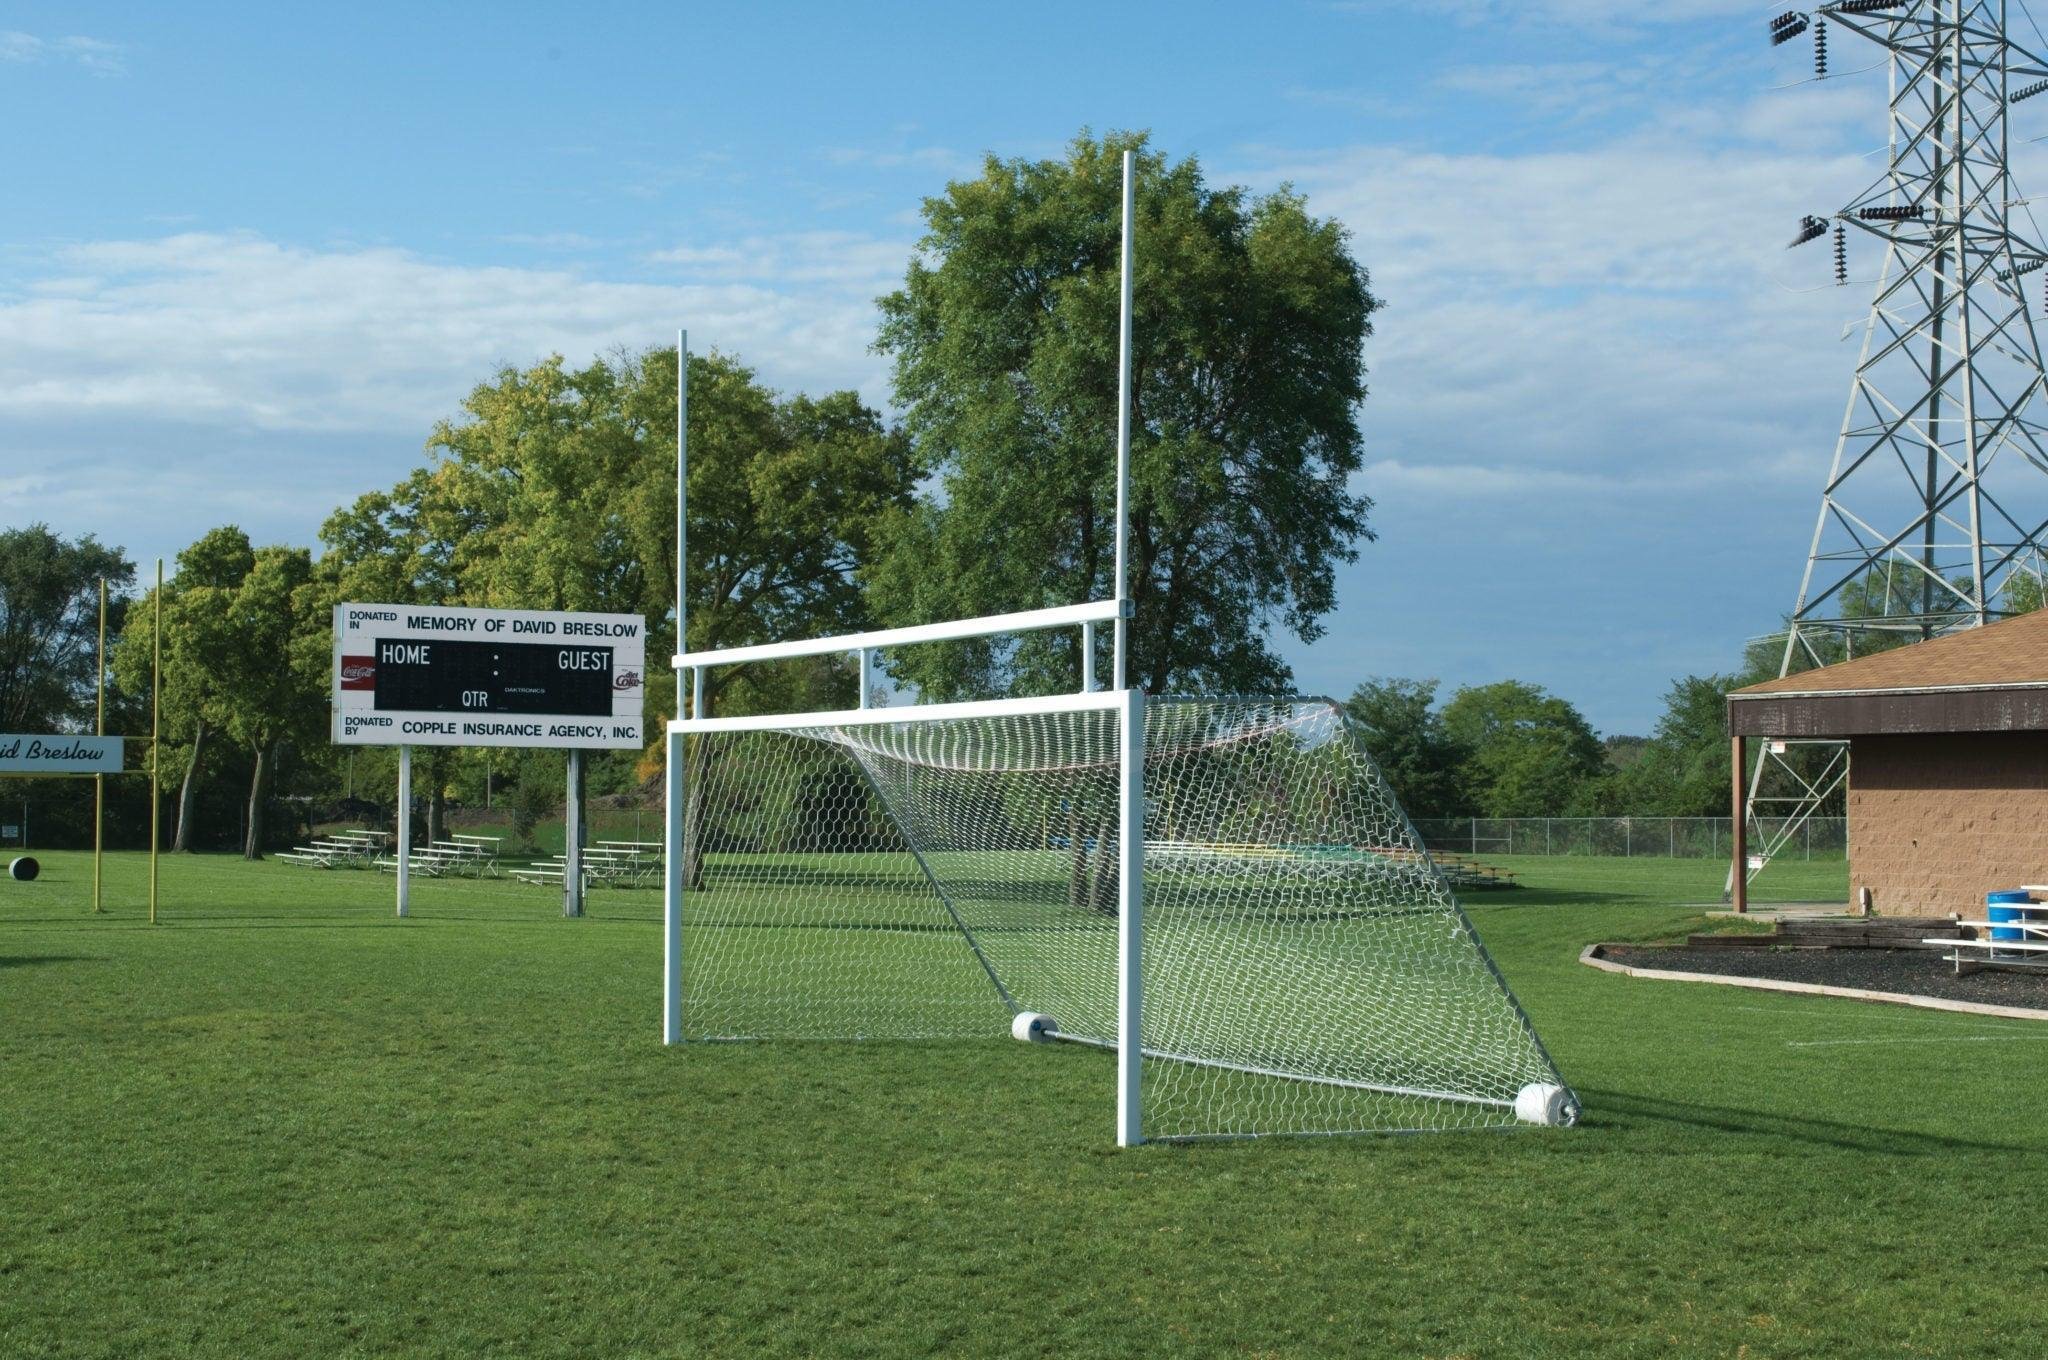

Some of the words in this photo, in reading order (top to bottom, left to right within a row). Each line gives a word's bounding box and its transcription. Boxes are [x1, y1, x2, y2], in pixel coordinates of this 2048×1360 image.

[349, 611, 397, 621] DONATED
[349, 620, 360, 629] IN
[407, 616, 477, 632] MEMORY
[484, 619, 506, 632] OF
[513, 620, 557, 634] DAVID
[563, 622, 638, 637] BRESLOW
[382, 645, 430, 665] HOME
[558, 650, 609, 671] GUEST
[462, 691, 488, 707] QTR
[345, 717, 393, 727] DONATED
[402, 721, 457, 735] COPPLE
[463, 723, 542, 737] INSURANCE
[549, 725, 607, 740] AGENCY,
[612, 726, 639, 739] INC.
[345, 726, 358, 736] BY
[25, 739, 104, 760] Breslow
